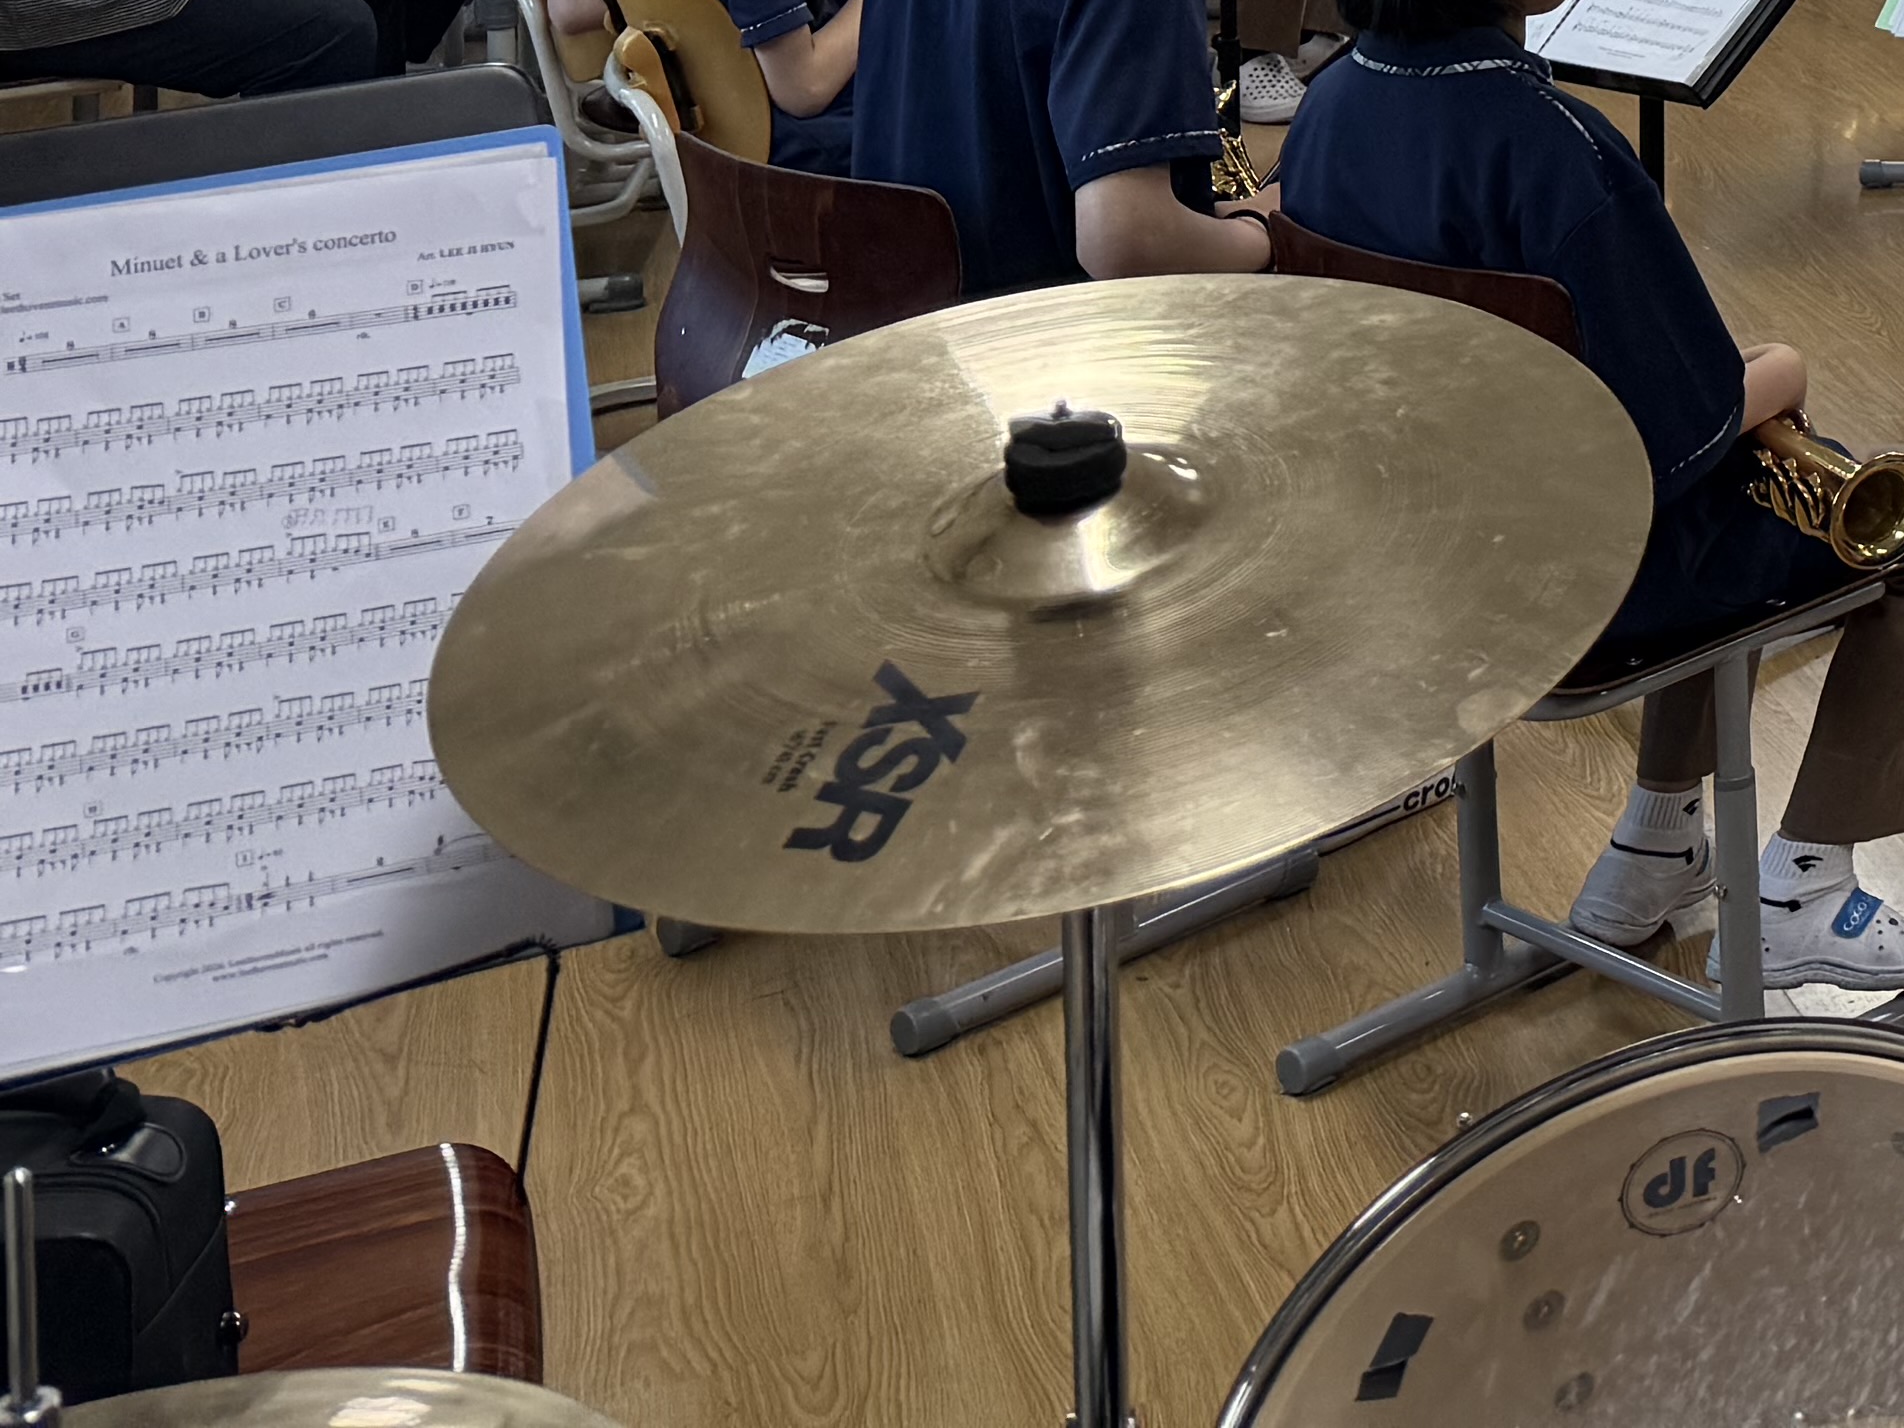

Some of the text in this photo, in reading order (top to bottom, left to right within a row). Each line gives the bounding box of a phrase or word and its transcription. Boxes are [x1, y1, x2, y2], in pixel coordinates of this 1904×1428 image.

[110, 229, 398, 277] Minuet & a Lover's concerto
[782, 658, 982, 863] XSR
[1402, 774, 1454, 812] cro
[1642, 1146, 1716, 1209] df
